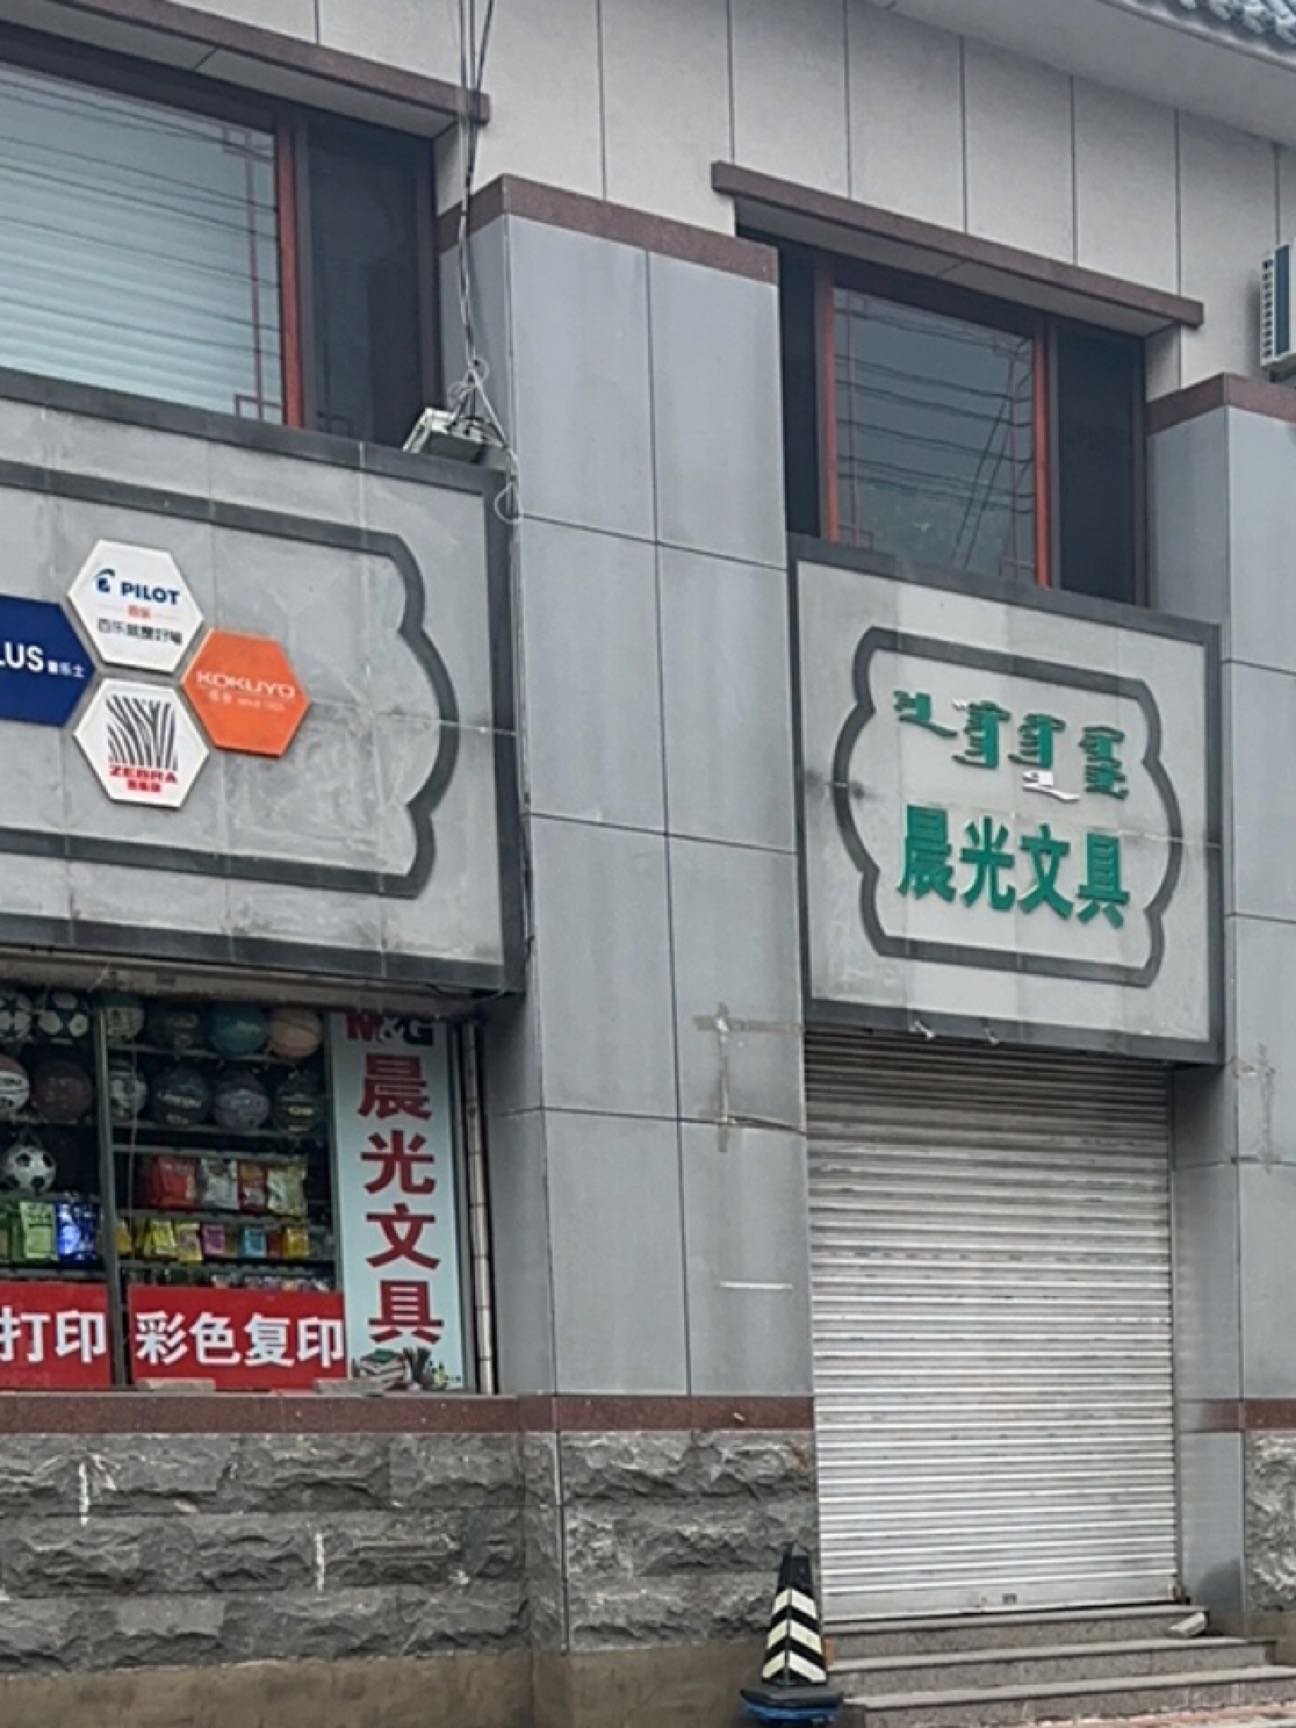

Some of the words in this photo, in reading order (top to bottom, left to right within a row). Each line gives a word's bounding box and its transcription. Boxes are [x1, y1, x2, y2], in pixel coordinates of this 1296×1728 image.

[121, 581, 179, 605] PILOT
[196, 671, 296, 699] KOKUYO
[109, 764, 178, 784] ZEBRA
[898, 804, 1130, 929] 晨光文具
[358, 1054, 444, 1345] 晨光文具
[0, 1307, 106, 1363] 打印
[136, 1310, 344, 1369] 彩色复印
